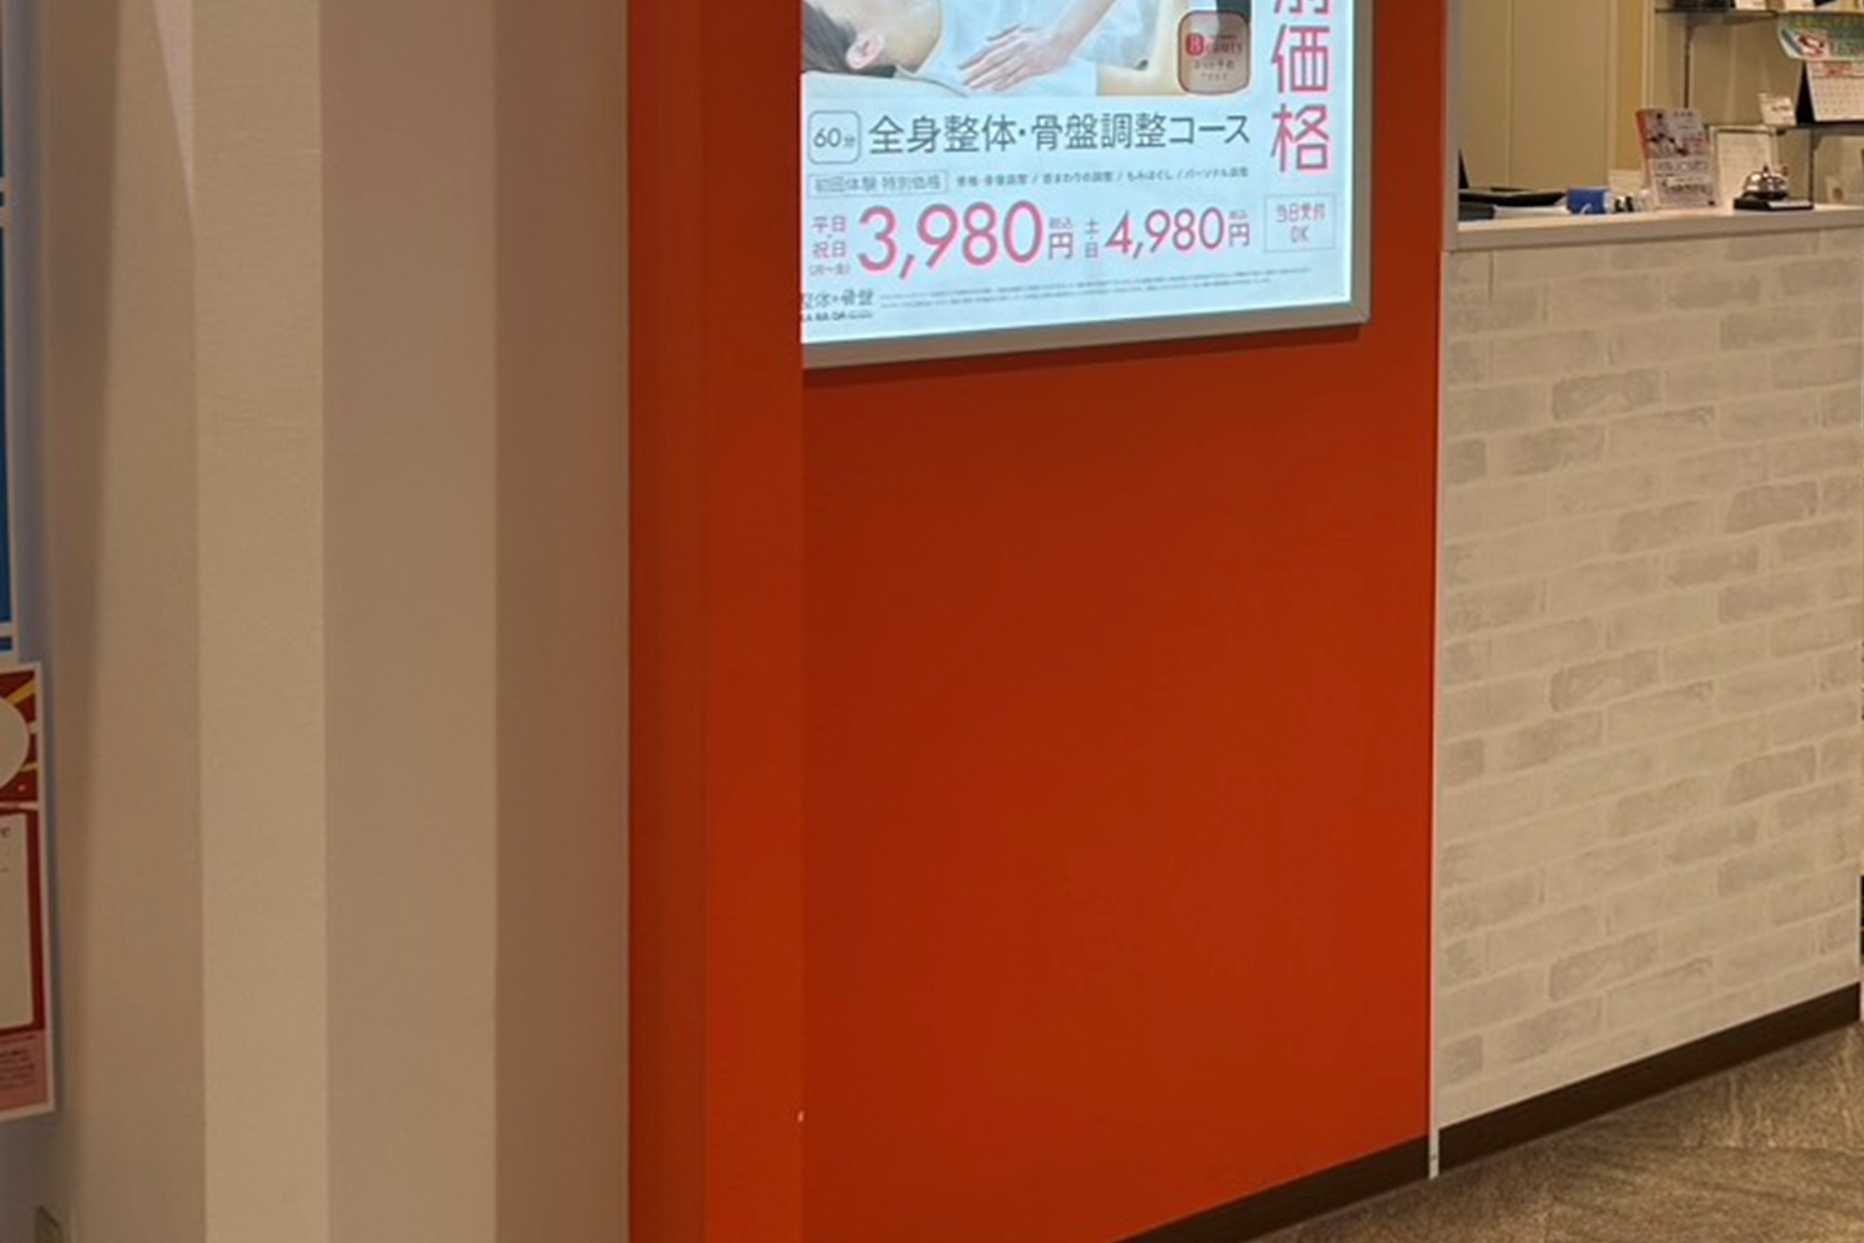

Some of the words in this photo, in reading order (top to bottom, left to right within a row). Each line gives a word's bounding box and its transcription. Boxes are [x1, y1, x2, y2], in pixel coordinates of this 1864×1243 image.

[869, 113, 1250, 155] 全身整体・骨盤調整コース
